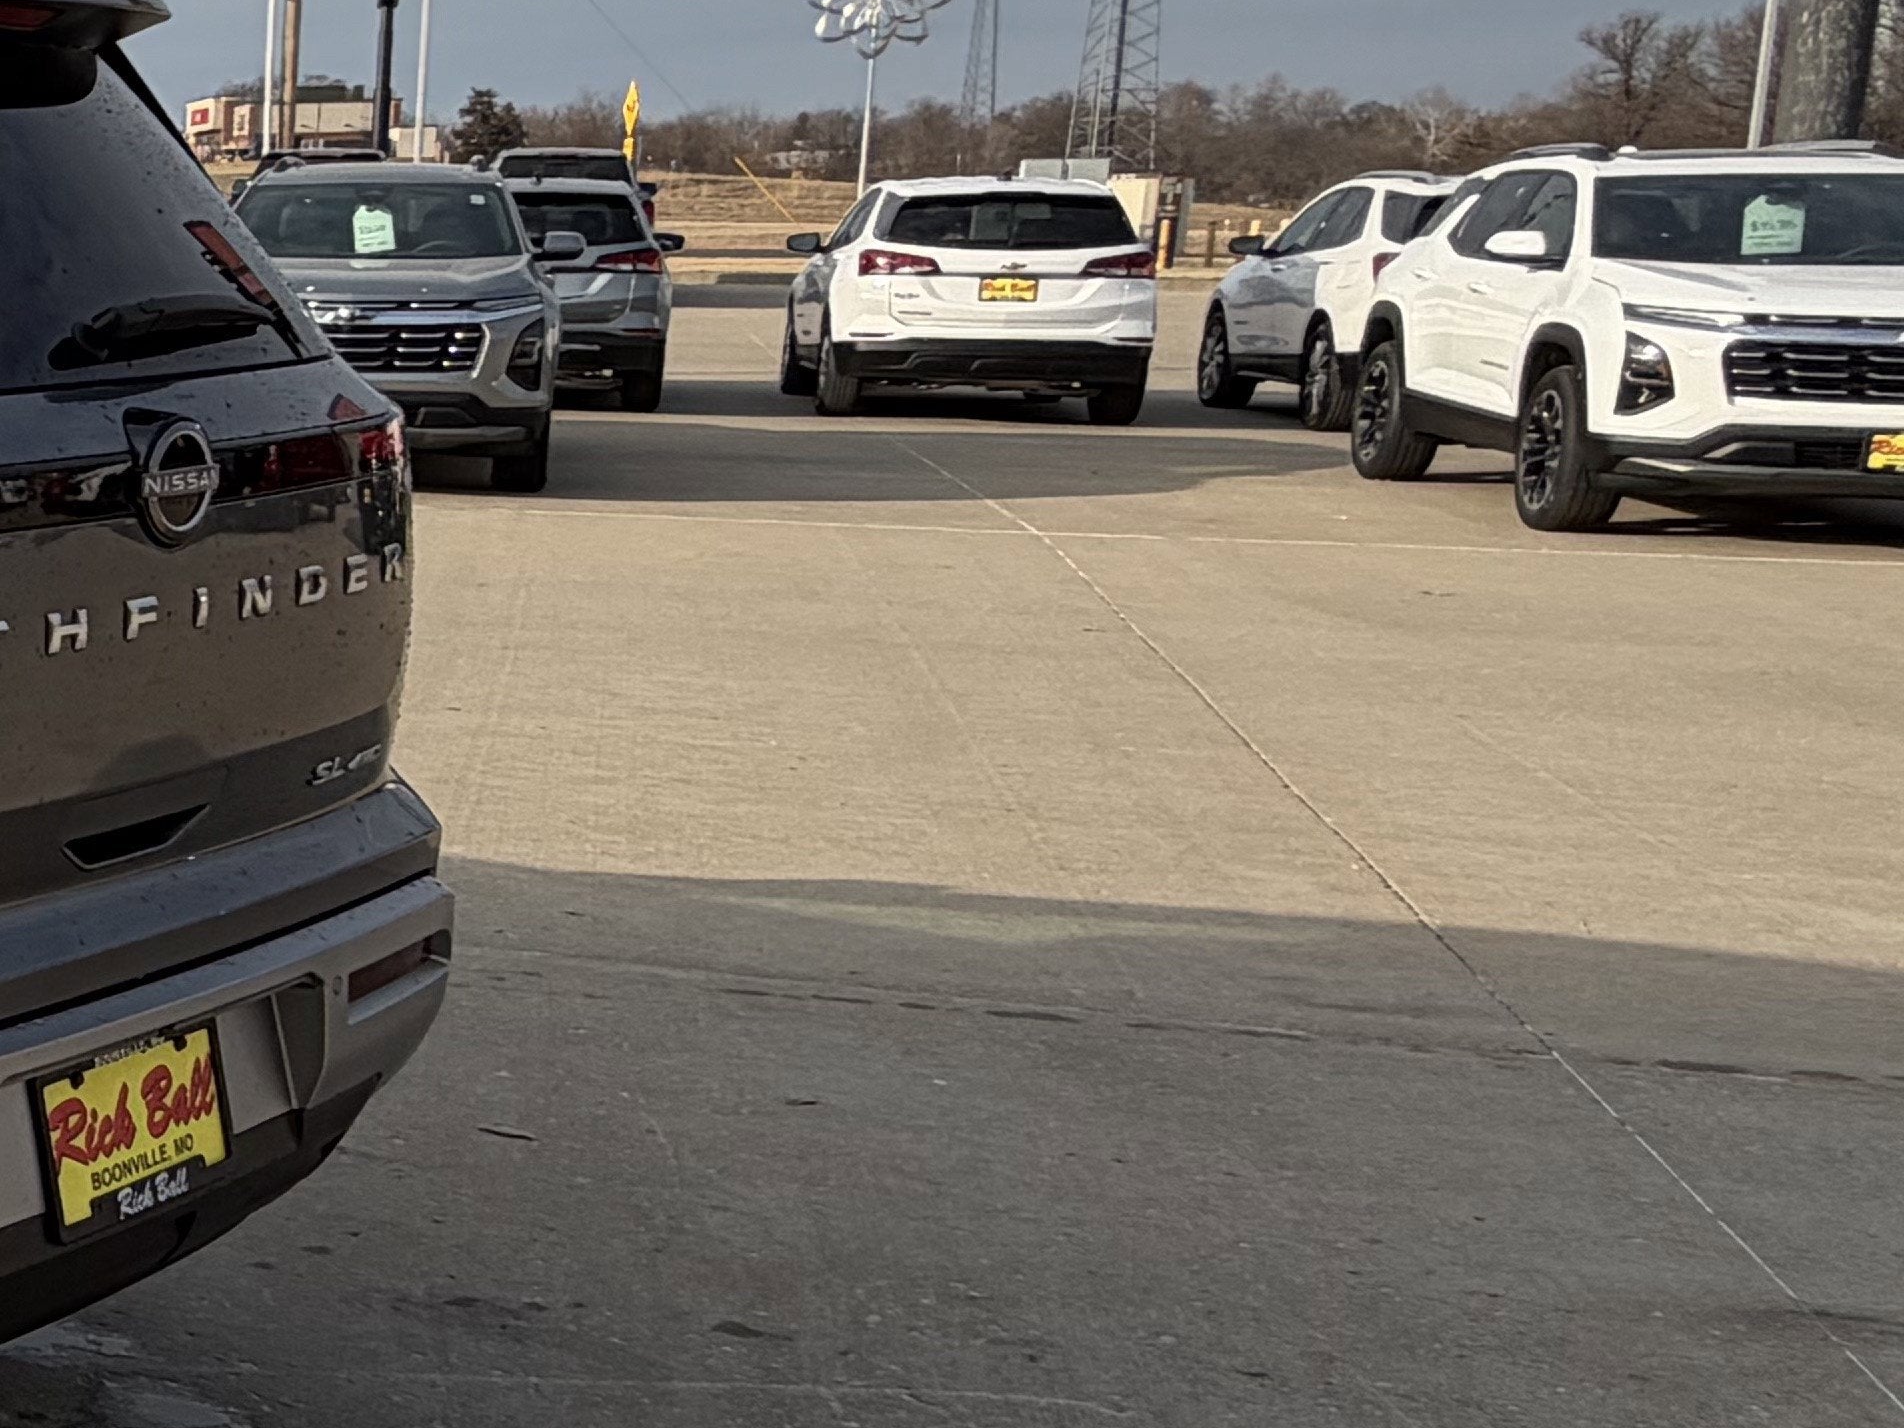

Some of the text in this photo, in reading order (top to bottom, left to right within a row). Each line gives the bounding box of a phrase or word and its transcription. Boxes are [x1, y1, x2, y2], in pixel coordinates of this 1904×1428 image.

[310, 756, 346, 786] SL
[47, 1052, 216, 1177] Rick Ball
[91, 1132, 195, 1191] BOONVILLE, MO
[116, 1166, 191, 1221] Rick Ball
